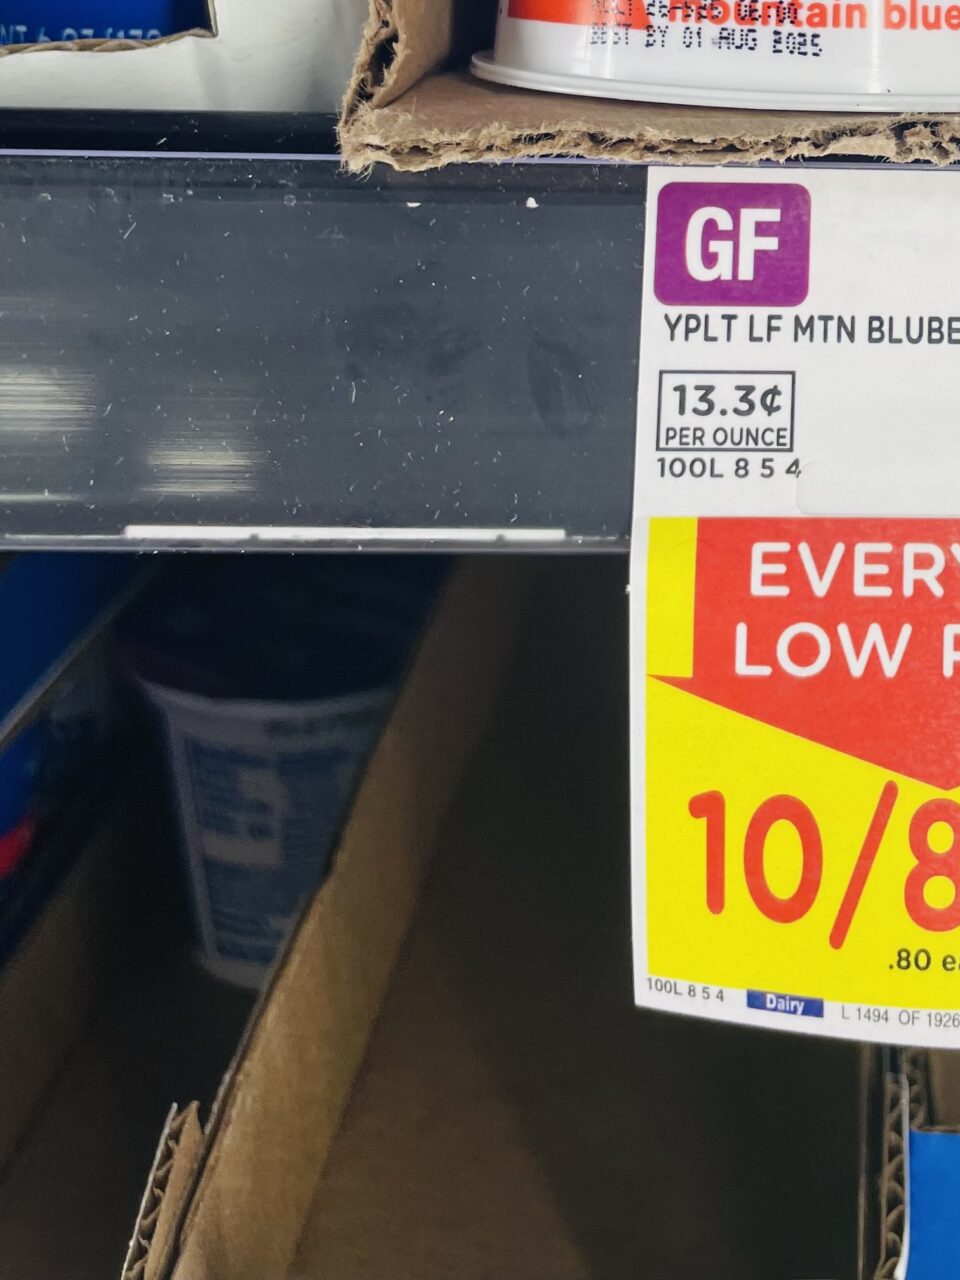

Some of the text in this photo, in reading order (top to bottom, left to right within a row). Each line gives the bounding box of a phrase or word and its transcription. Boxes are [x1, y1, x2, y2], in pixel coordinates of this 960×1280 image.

[644, 23, 669, 49] BY
[682, 25, 703, 49] 01
[716, 26, 758, 52] AUG
[771, 29, 823, 57] 2025
[685, 205, 782, 282] GF
[664, 313, 739, 343] YPLT
[748, 314, 784, 343] LF
[793, 314, 856, 344] MTN
[672, 384, 783, 418] 13.3¢
[665, 427, 788, 448] PER OUNCE
[656, 457, 802, 479] 100L 8 5 4
[734, 621, 912, 679] LOW
[888, 947, 932, 972] .80
[646, 976, 725, 1003] 100L 8 5 4
[765, 993, 805, 1016] Dairy
[841, 1005, 850, 1020] L
[856, 1006, 889, 1023] 1494
[898, 1009, 920, 1027] OF
[926, 1011, 960, 1029] 1926
